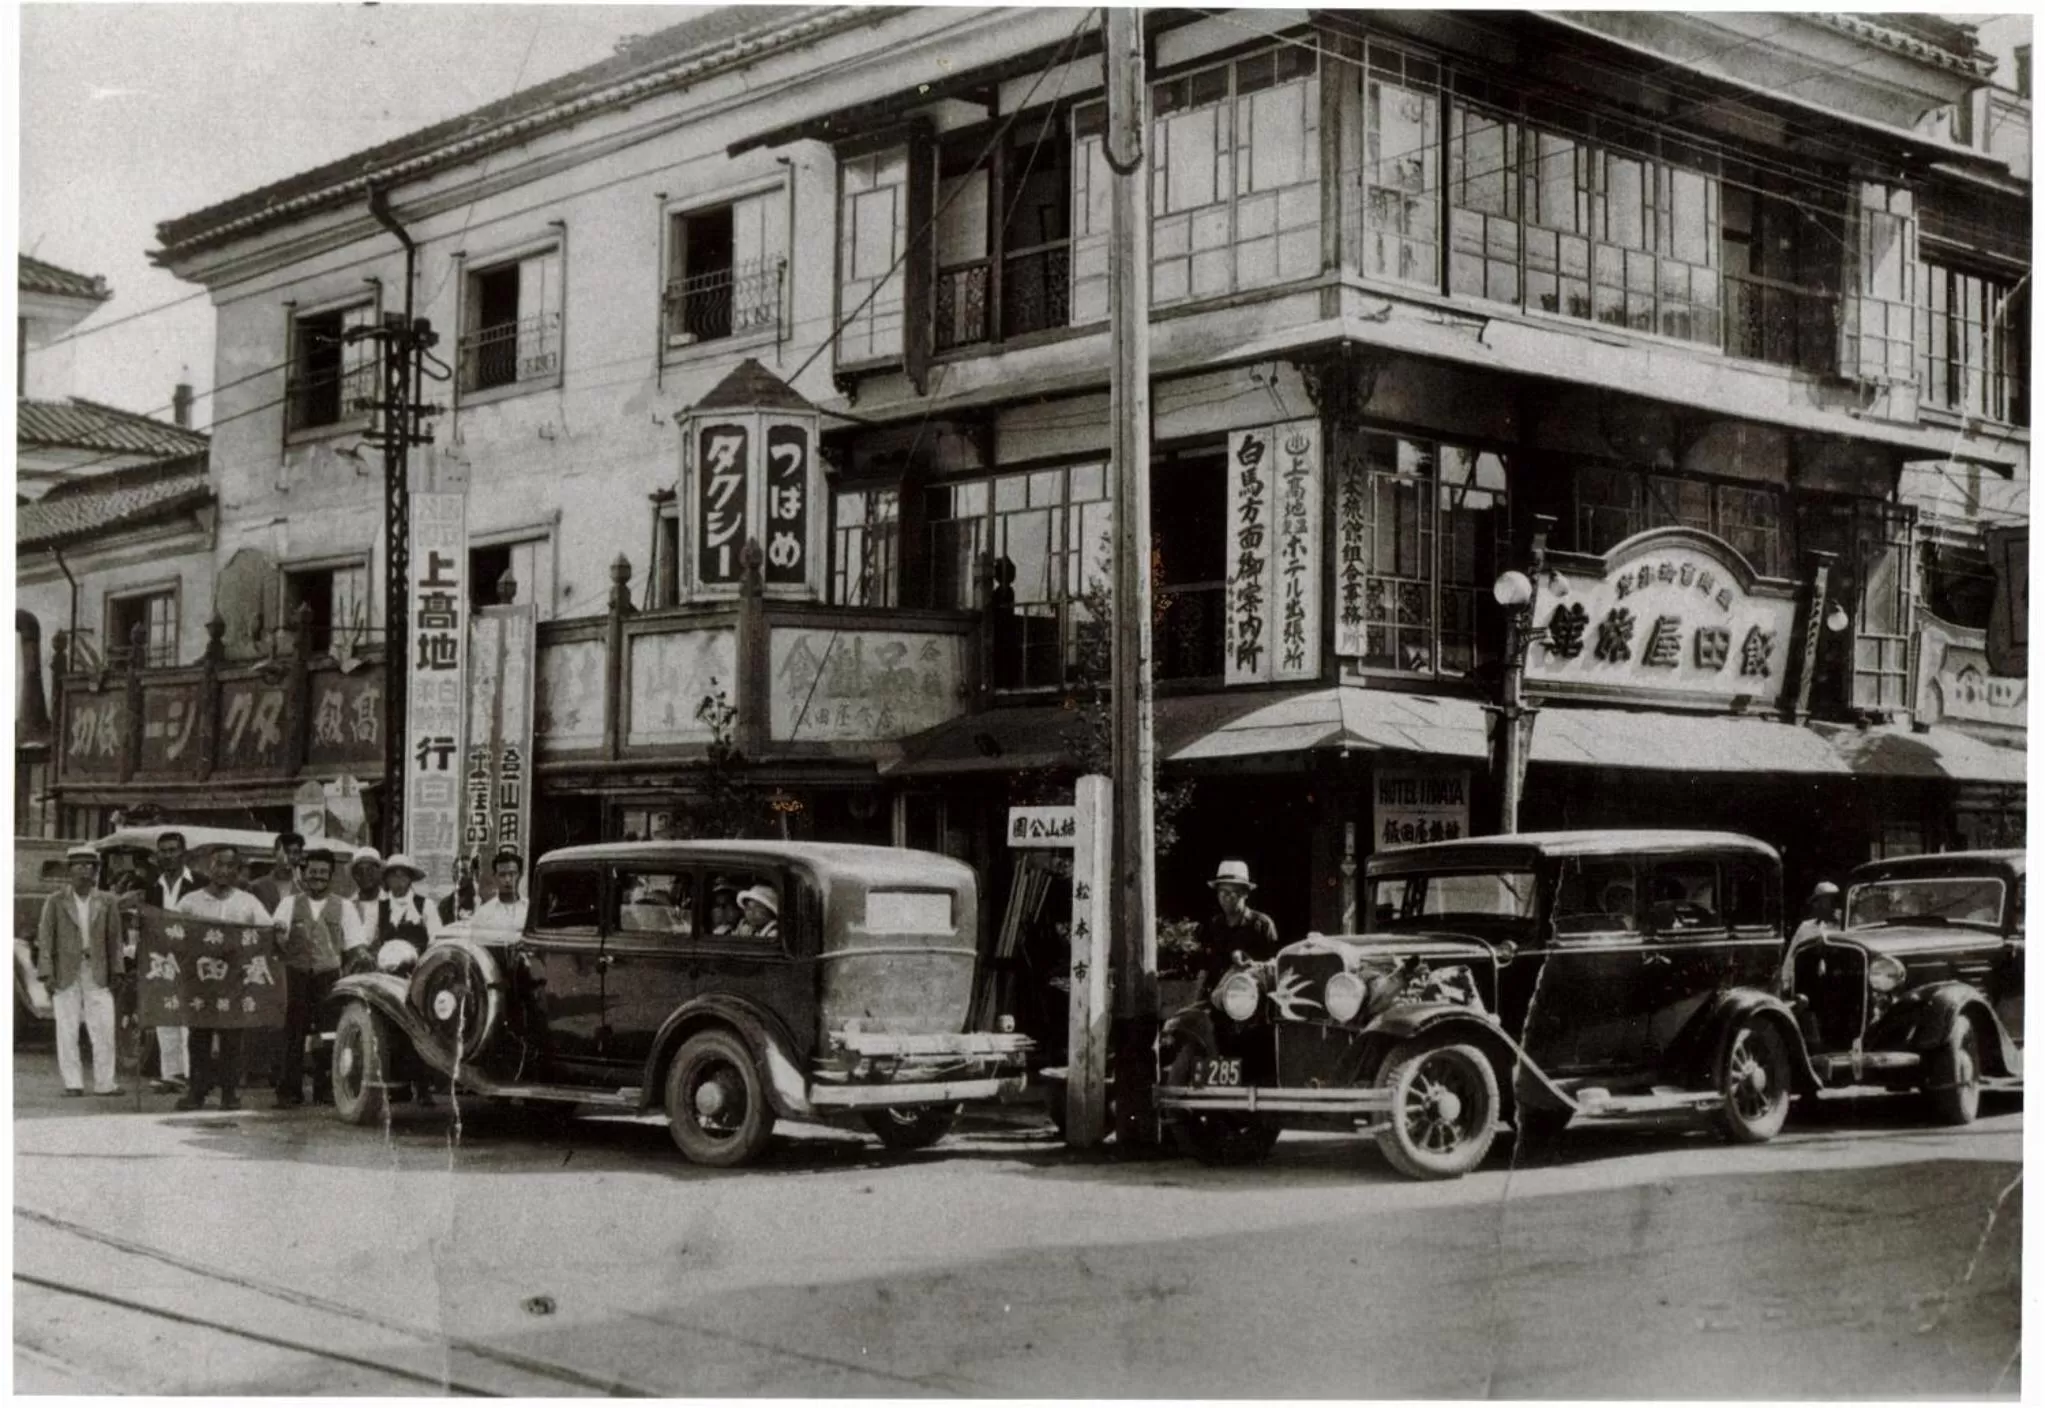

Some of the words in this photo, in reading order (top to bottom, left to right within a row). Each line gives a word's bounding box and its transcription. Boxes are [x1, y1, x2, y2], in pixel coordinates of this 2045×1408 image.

[706, 435, 745, 577] タクシー
[769, 443, 803, 568] つばめ
[1235, 434, 1265, 674] 白馬方面御案内所
[1072, 881, 1091, 984] 松本市
[1207, 1060, 1241, 1085] 285
